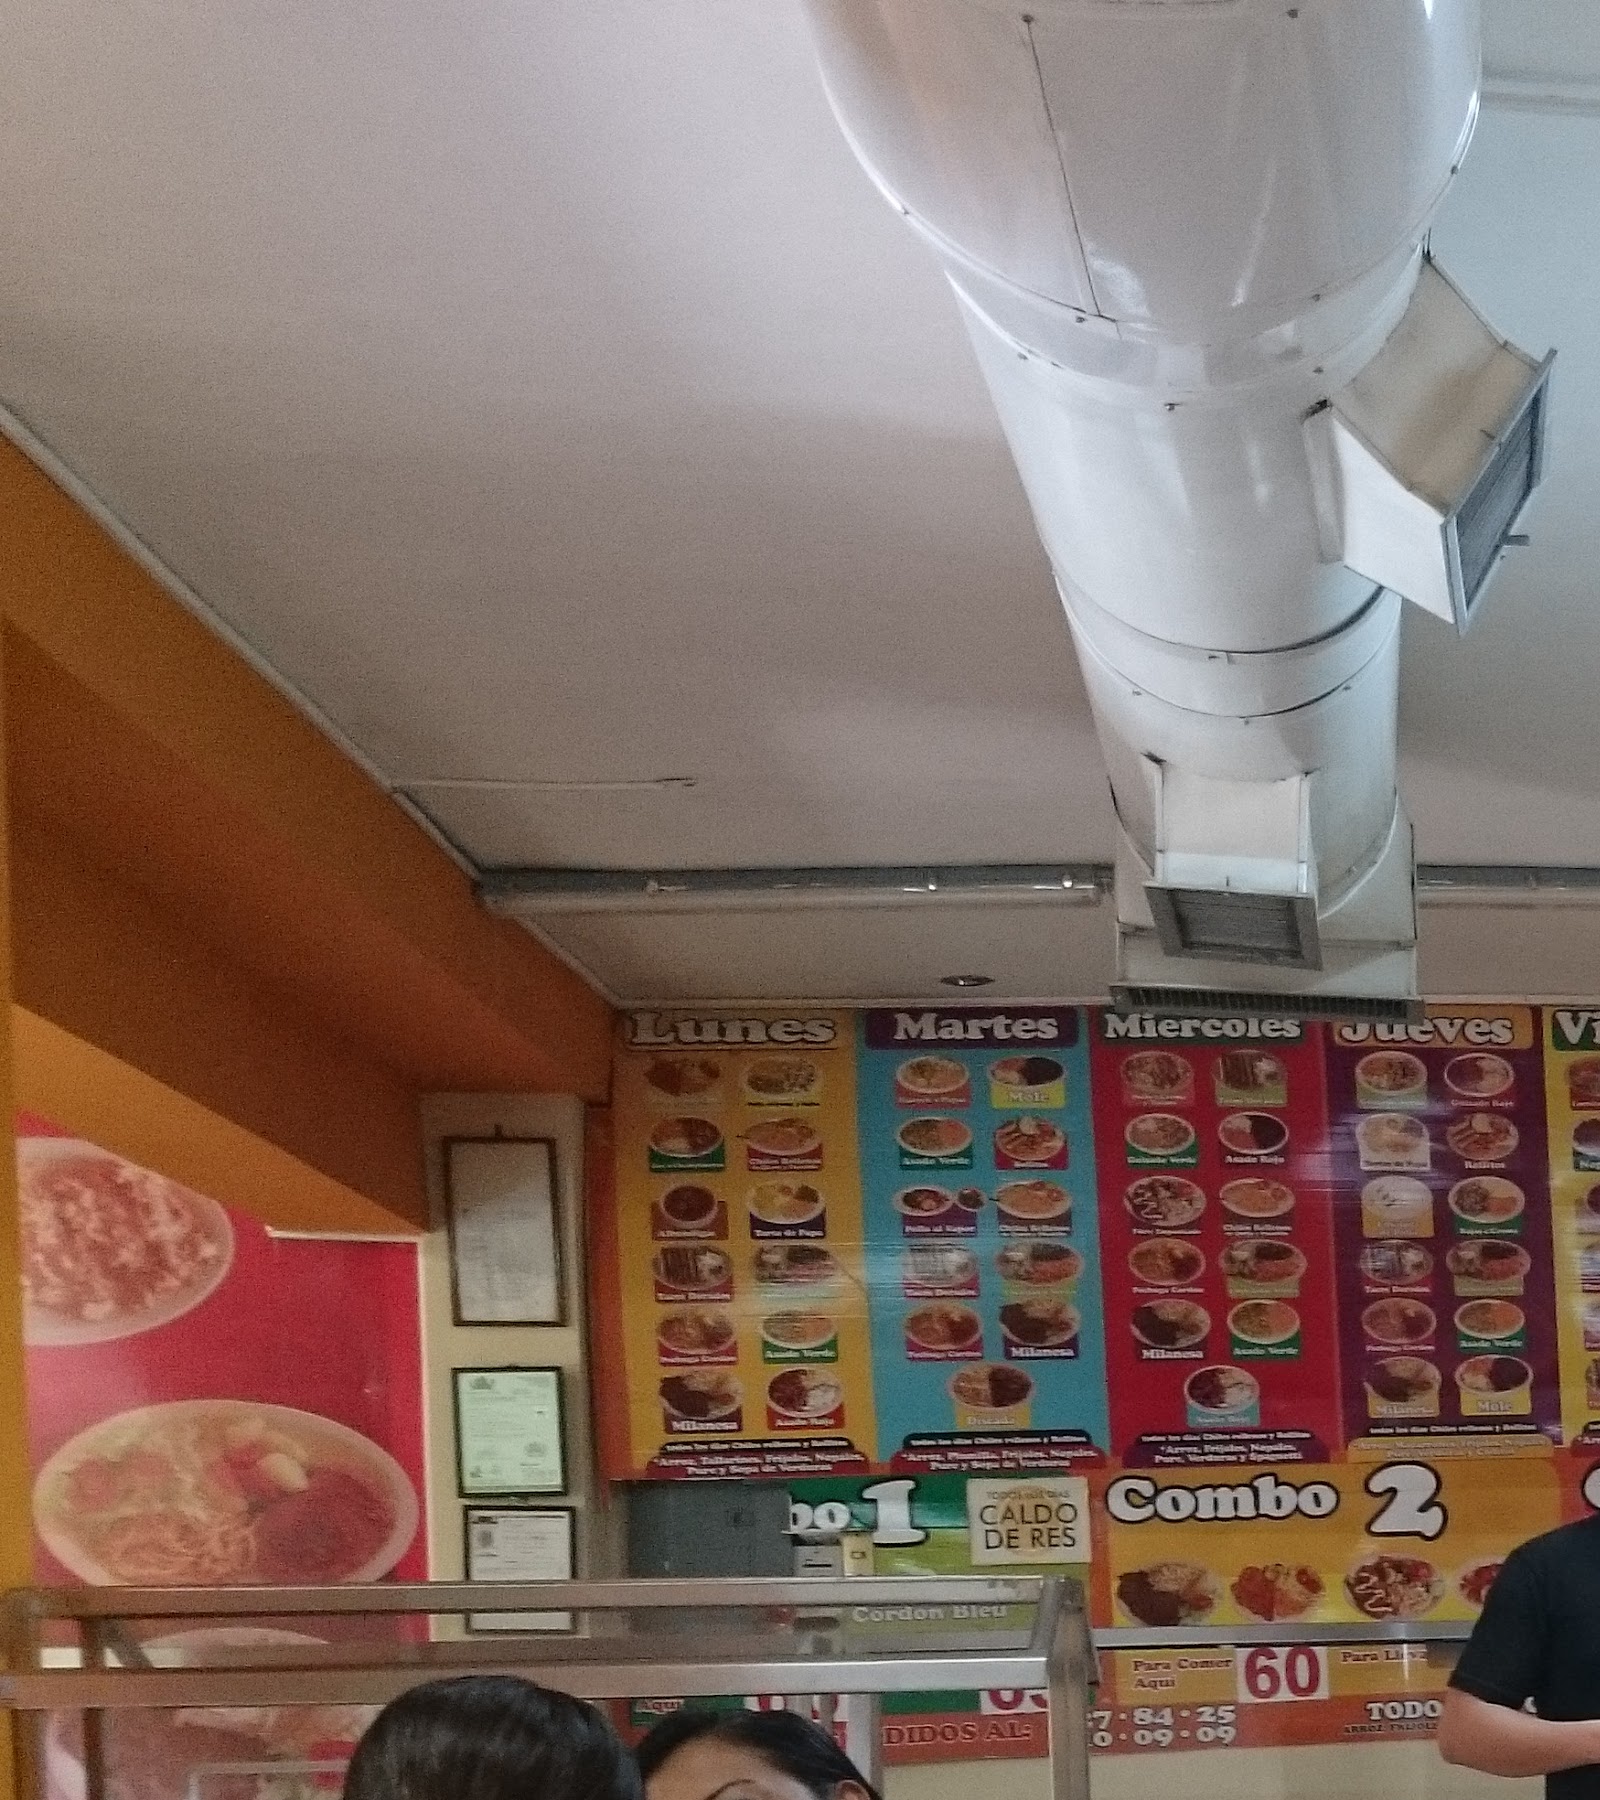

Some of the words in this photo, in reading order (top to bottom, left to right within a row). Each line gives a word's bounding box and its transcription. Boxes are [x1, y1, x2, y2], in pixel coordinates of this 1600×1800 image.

[632, 1012, 836, 1043] Lunes
[893, 1012, 1059, 1041] Martes
[1104, 1013, 1301, 1039] Miercoles
[1341, 1015, 1515, 1044] Jueves
[1011, 1347, 1074, 1357] Milanesa
[1143, 1350, 1203, 1359] Milanesa
[1477, 1402, 1513, 1411] Mole
[672, 1421, 738, 1431] Milanesa
[862, 1479, 927, 1544] 1
[1108, 1474, 1336, 1522] Combo
[1367, 1462, 1447, 1538] 2
[979, 1503, 1078, 1526] CALDO
[985, 1528, 1019, 1550] DE
[1031, 1527, 1076, 1549] RES
[852, 1605, 944, 1623] Cordon
[952, 1603, 1007, 1619] Bleu
[1133, 1659, 1172, 1672] Para
[1177, 1656, 1232, 1670] Comer
[1341, 1650, 1379, 1663] Para
[1133, 1675, 1176, 1690] Aqui
[1244, 1645, 1320, 1699] 60
